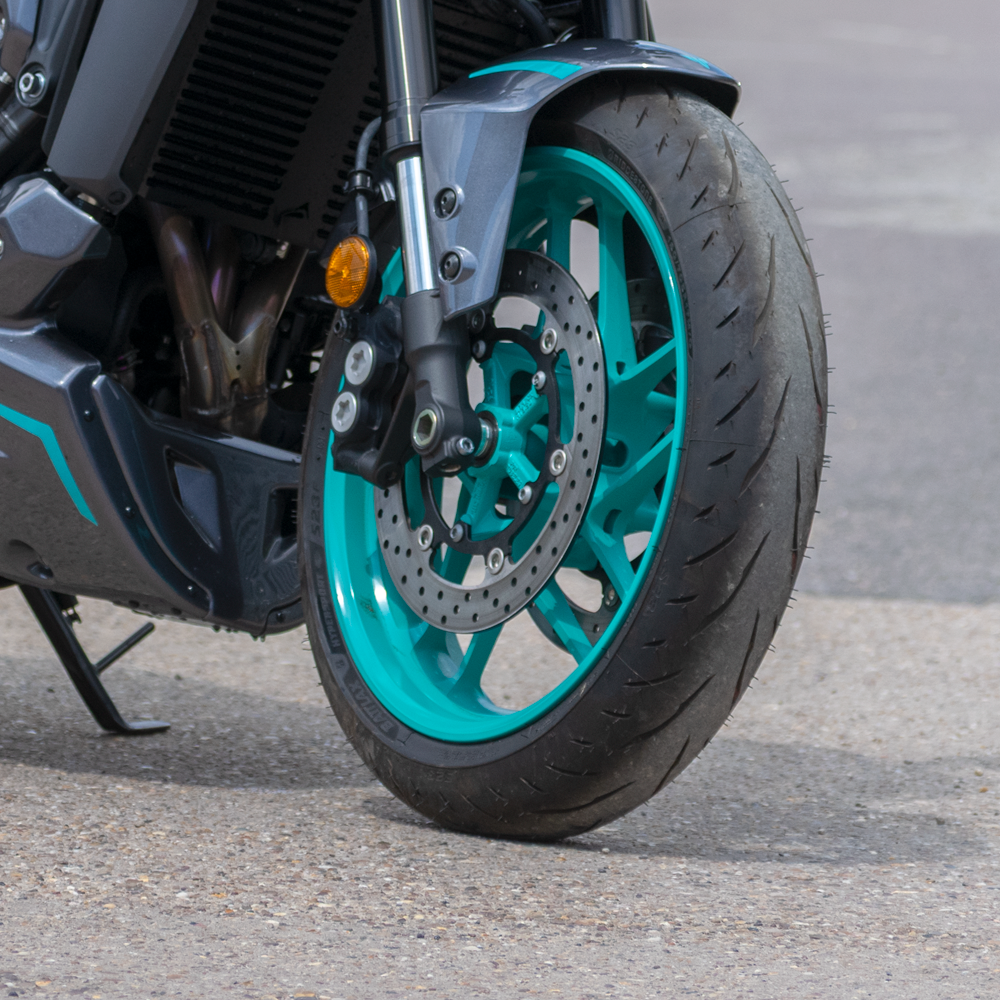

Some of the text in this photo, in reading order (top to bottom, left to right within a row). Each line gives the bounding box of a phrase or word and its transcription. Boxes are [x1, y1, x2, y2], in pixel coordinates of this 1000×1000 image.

[607, 148, 655, 206] BRIDGESTONE
[316, 574, 340, 647] HYPERSPORT
[348, 679, 394, 732] BATTLAX
